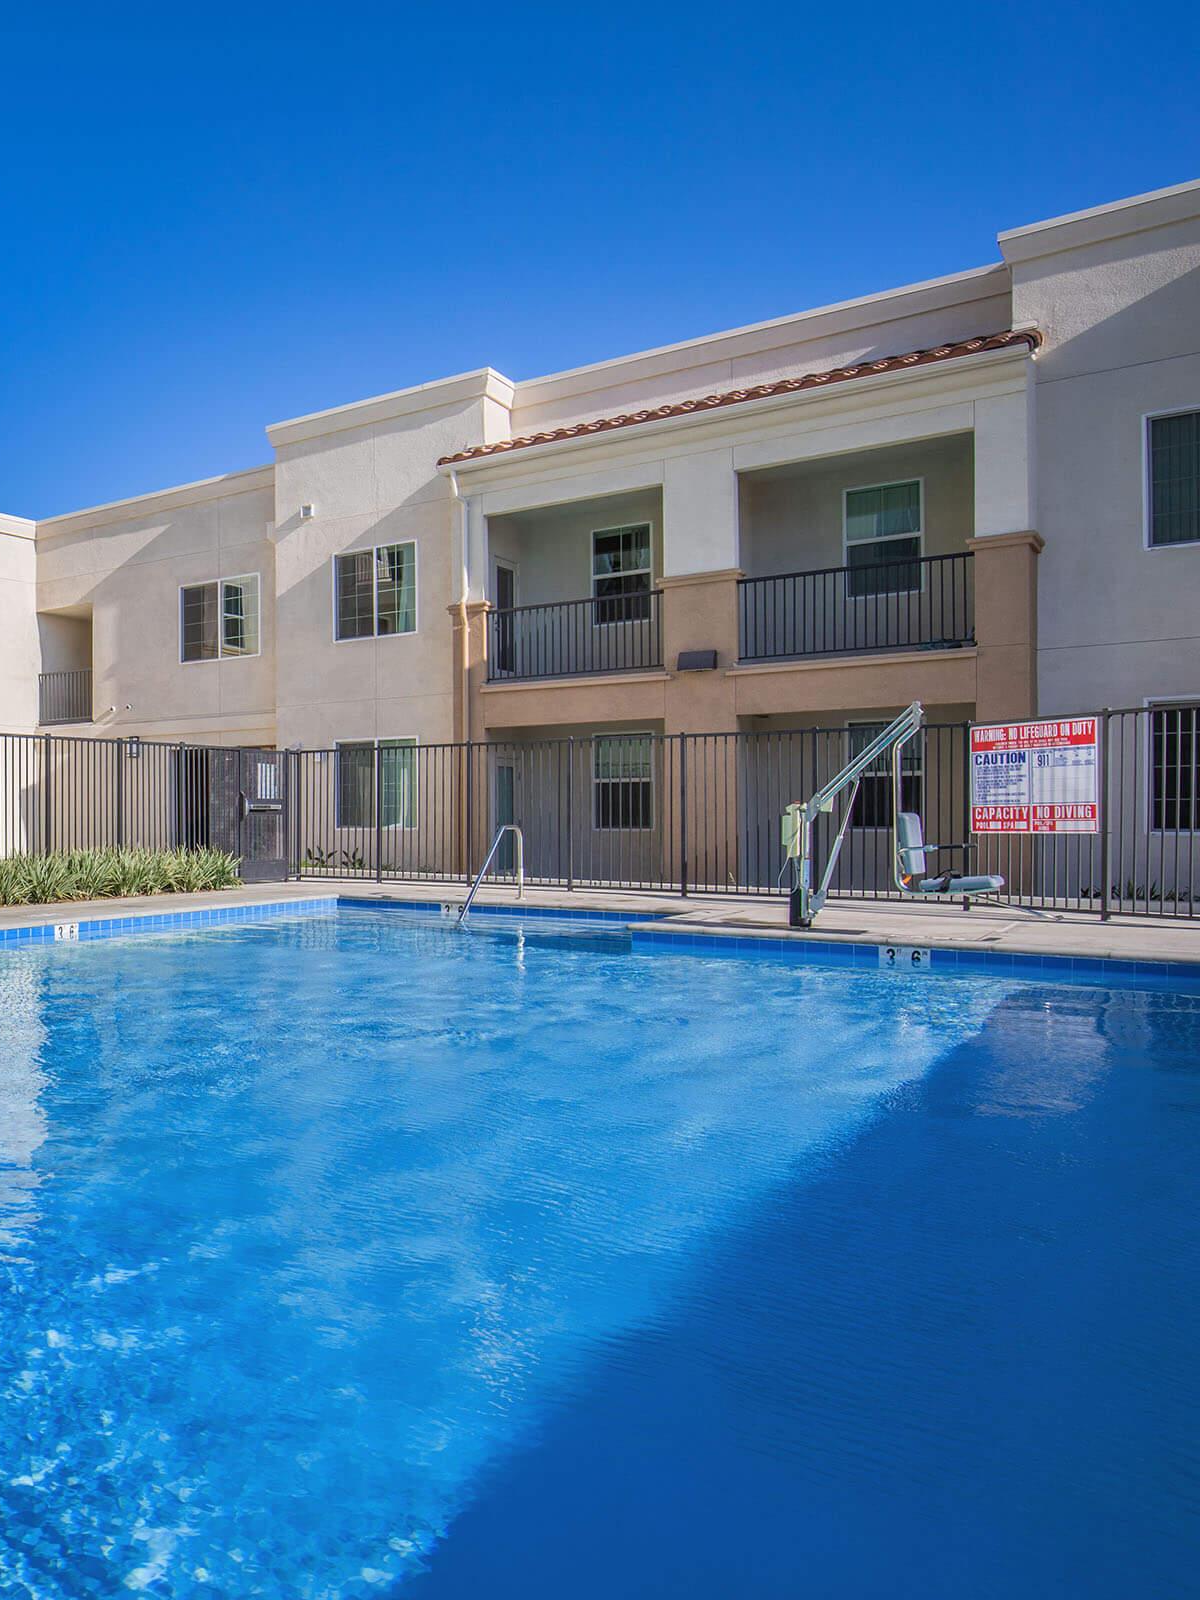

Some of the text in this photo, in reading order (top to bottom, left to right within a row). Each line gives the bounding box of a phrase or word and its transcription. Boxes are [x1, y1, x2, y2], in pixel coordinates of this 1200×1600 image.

[974, 720, 1093, 743] WARNING: NO LIFEGUARD ON DUTY
[975, 751, 1026, 766] CAUTION
[1037, 754, 1050, 767] 911
[975, 806, 1028, 820] CAPACITY
[1036, 805, 1092, 819] NO DIVING
